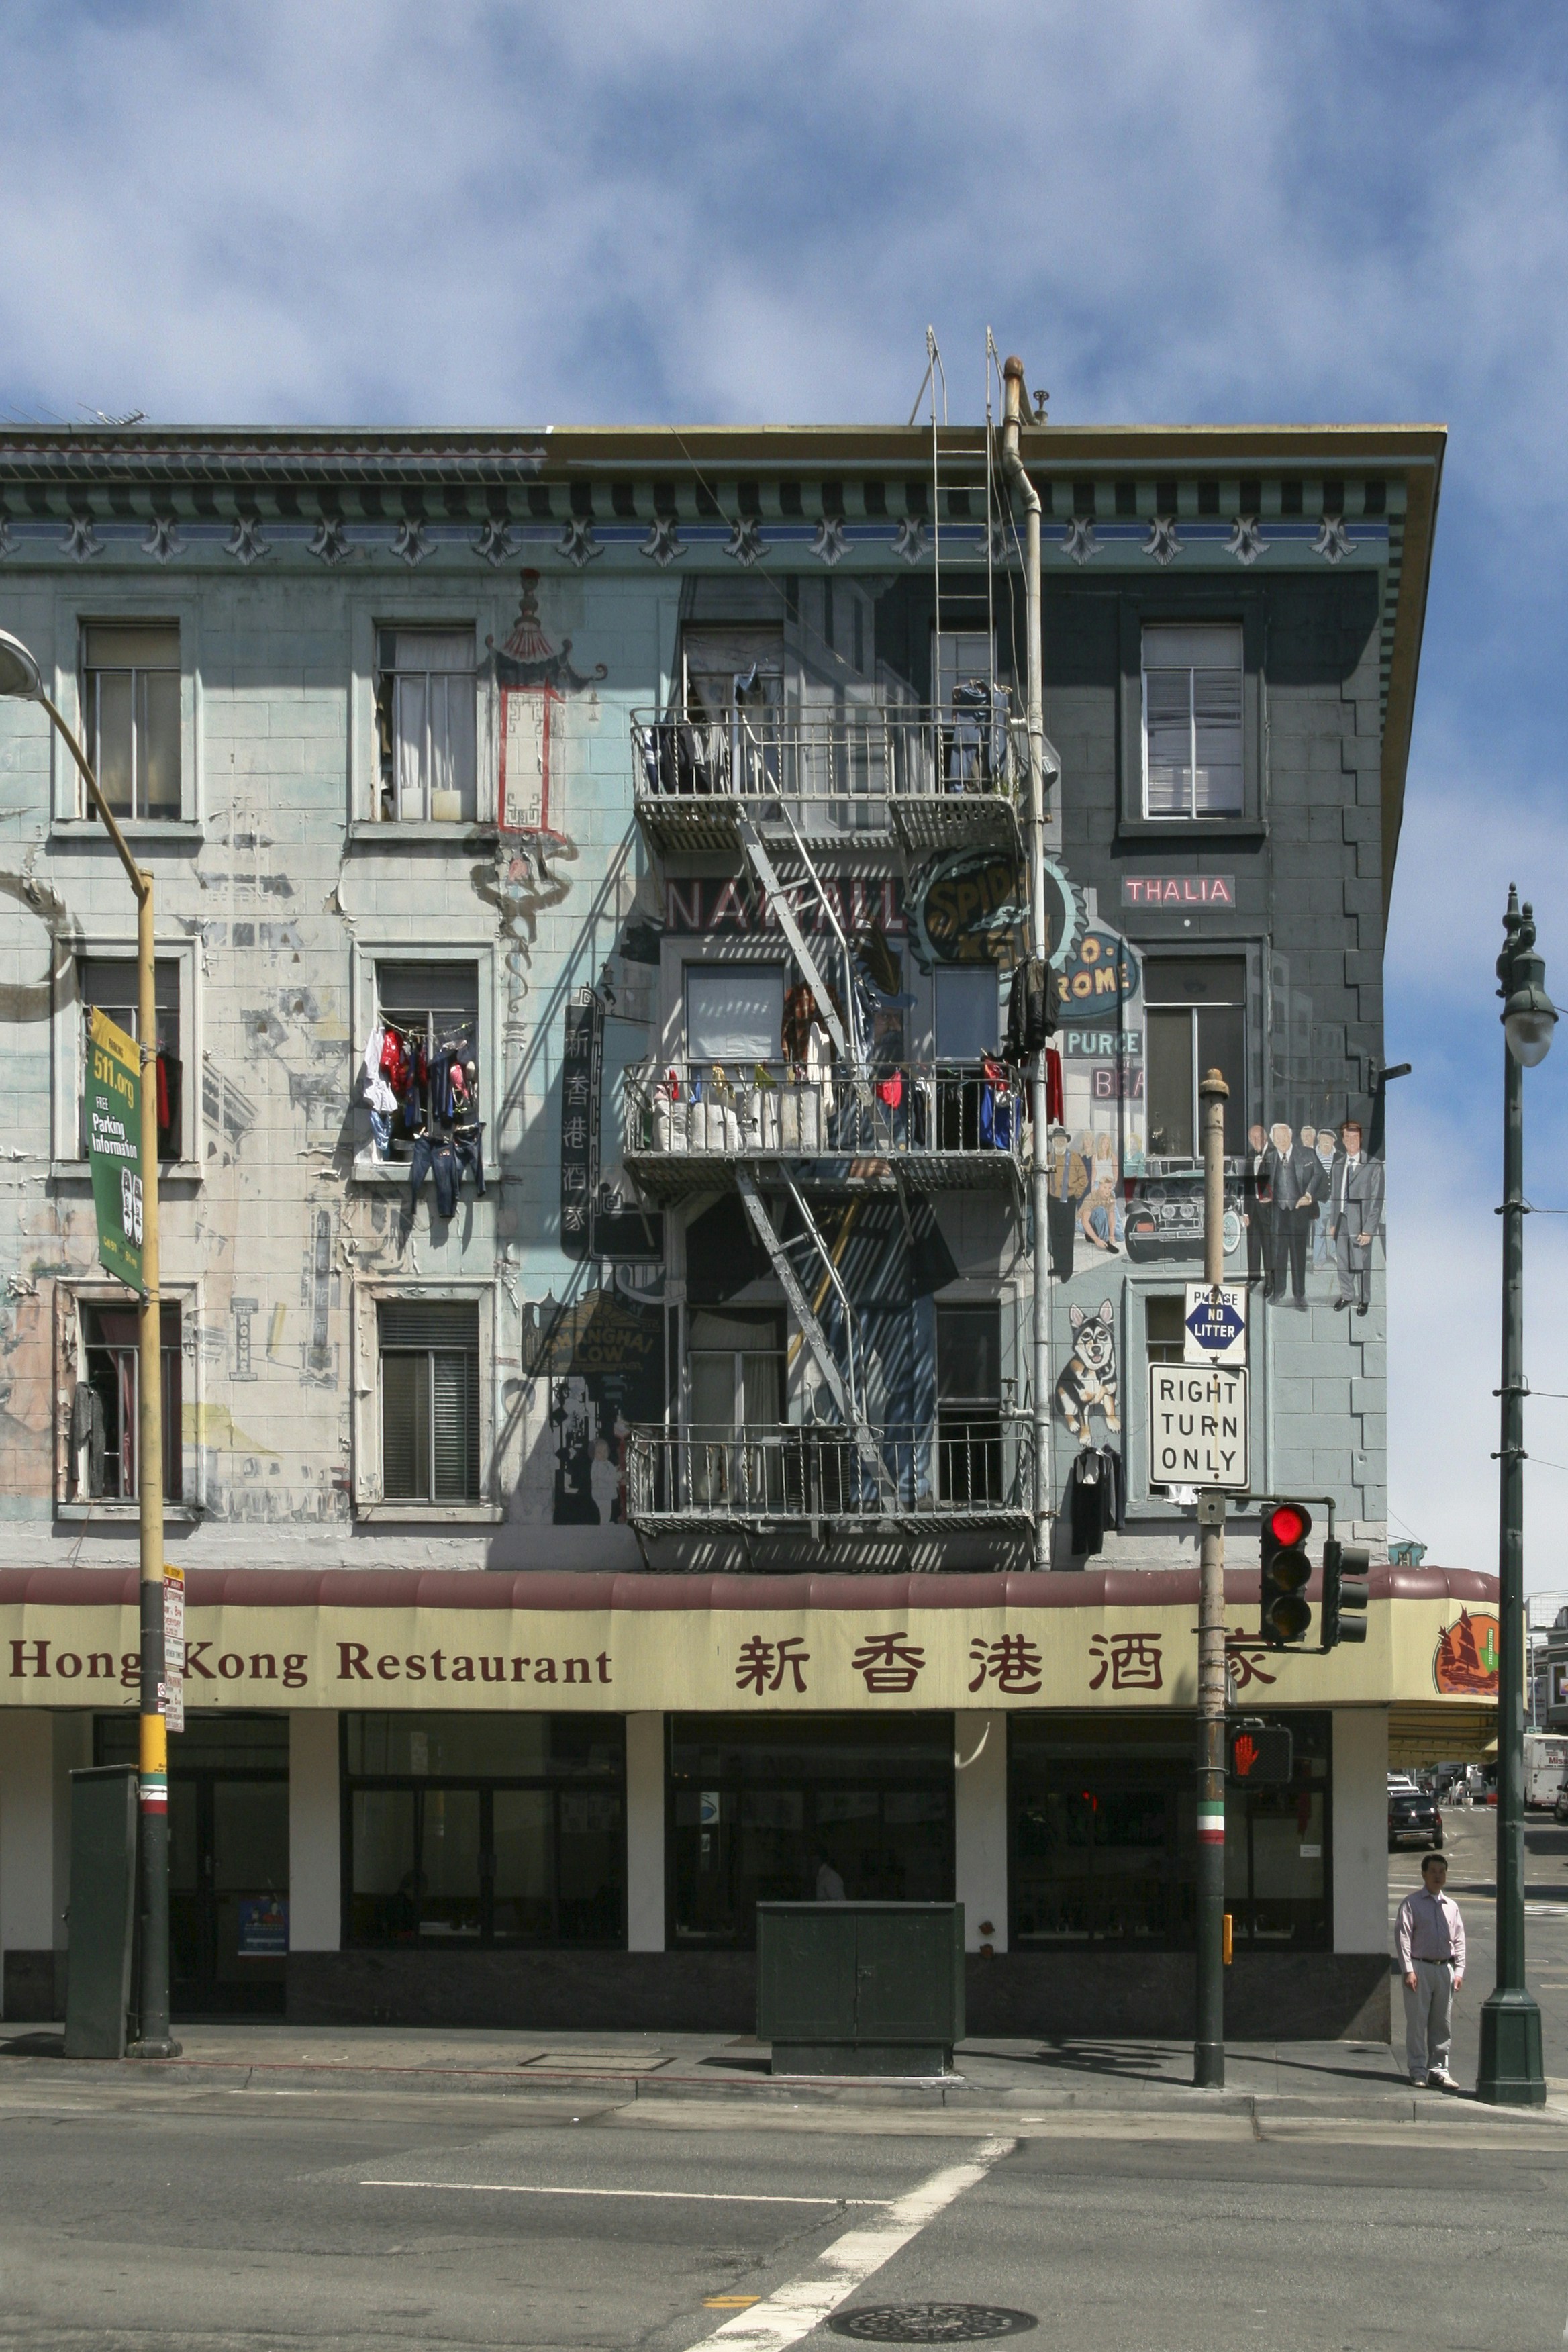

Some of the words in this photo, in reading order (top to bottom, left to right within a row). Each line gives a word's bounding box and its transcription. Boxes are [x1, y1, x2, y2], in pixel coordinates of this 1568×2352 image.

[1126, 879, 1230, 901] THALIA
[93, 1049, 134, 1109] 511.org
[95, 1095, 109, 1111] FREE
[91, 1112, 126, 1140] Parking
[563, 1028, 589, 1232] 新香港酒家
[91, 1132, 138, 1159] Information
[1193, 1291, 1238, 1306] PLEASE
[1208, 1308, 1224, 1322] NO
[546, 1326, 654, 1355] SHANGHAI
[1194, 1324, 1235, 1338] LITTER
[239, 1315, 248, 1373] ROOMS
[574, 1344, 625, 1362] LOW
[1160, 1379, 1237, 1404] RIGHT
[1161, 1413, 1237, 1438] TURN
[1161, 1447, 1236, 1472] ONLY
[9, 1639, 141, 1688] Hong
[182, 1641, 308, 1689] Kong
[336, 1642, 613, 1684] Restaurant
[735, 1631, 1277, 1696] 新香港酒家
